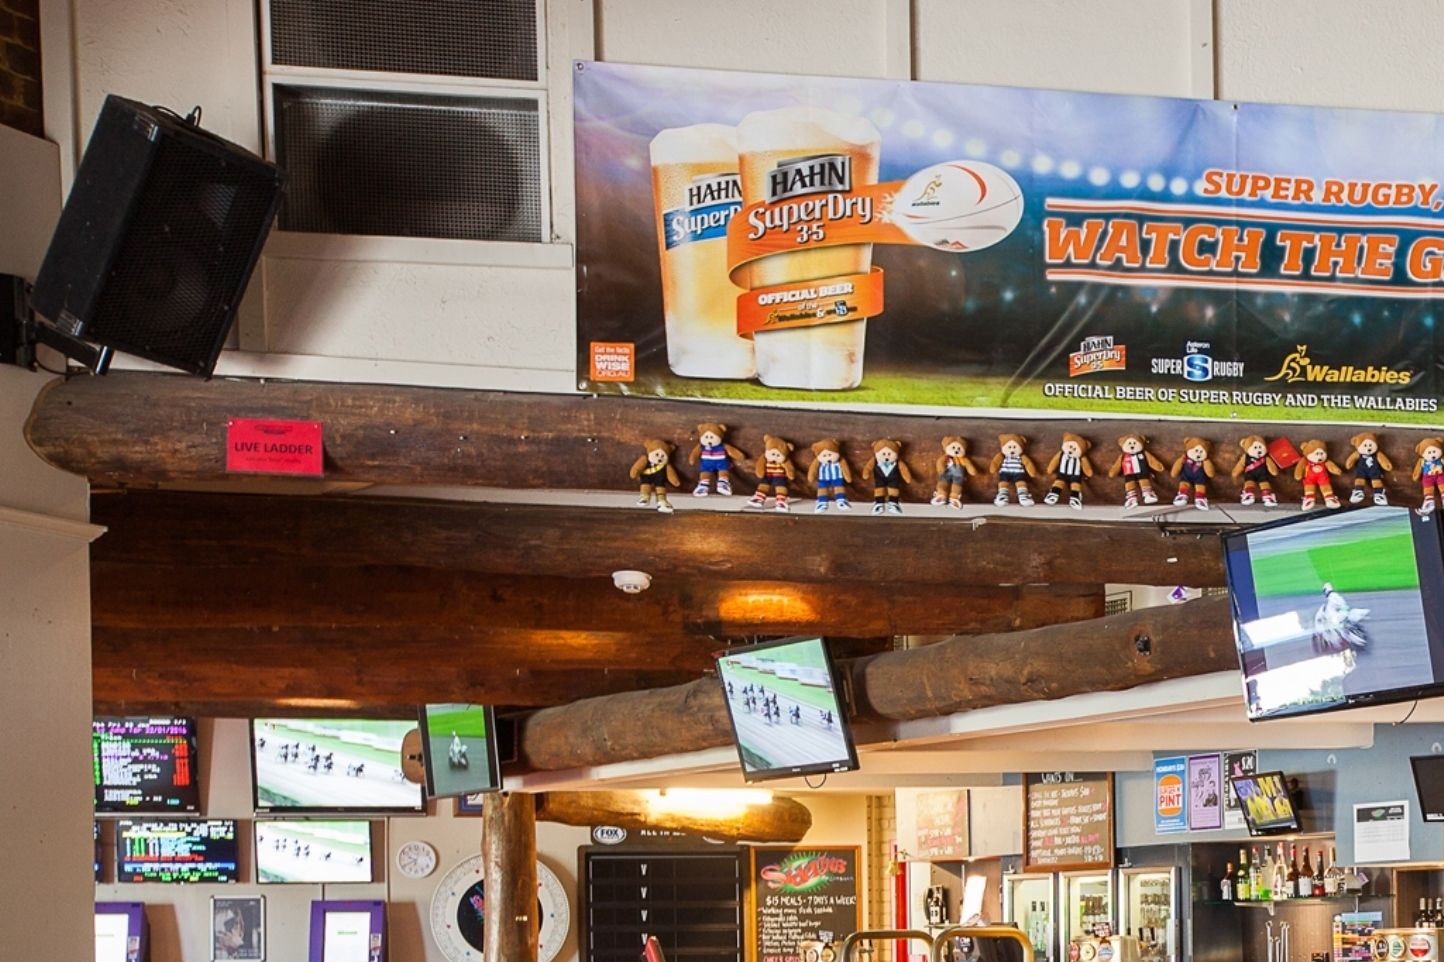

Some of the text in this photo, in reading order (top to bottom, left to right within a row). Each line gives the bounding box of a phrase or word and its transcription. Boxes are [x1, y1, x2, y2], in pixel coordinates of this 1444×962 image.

[770, 160, 847, 199] HAHN
[1202, 169, 1314, 202] SUPER
[1322, 178, 1442, 211] RUGBY,
[1044, 217, 1266, 274] WATCH
[1277, 229, 1399, 280] THE
[758, 282, 854, 305] OFFICIAL BEER
[1151, 357, 1183, 375] SUPER
[1213, 361, 1245, 378] RUGBY
[1306, 364, 1411, 385] Wallabies
[1044, 383, 1438, 412] OFFICIAL BEER OF SUPER RUGBY AND THE WALLABIES
[234, 441, 313, 455] LIVE LADDER
[1159, 793, 1182, 808] PINT
[600, 828, 620, 837] FOX
